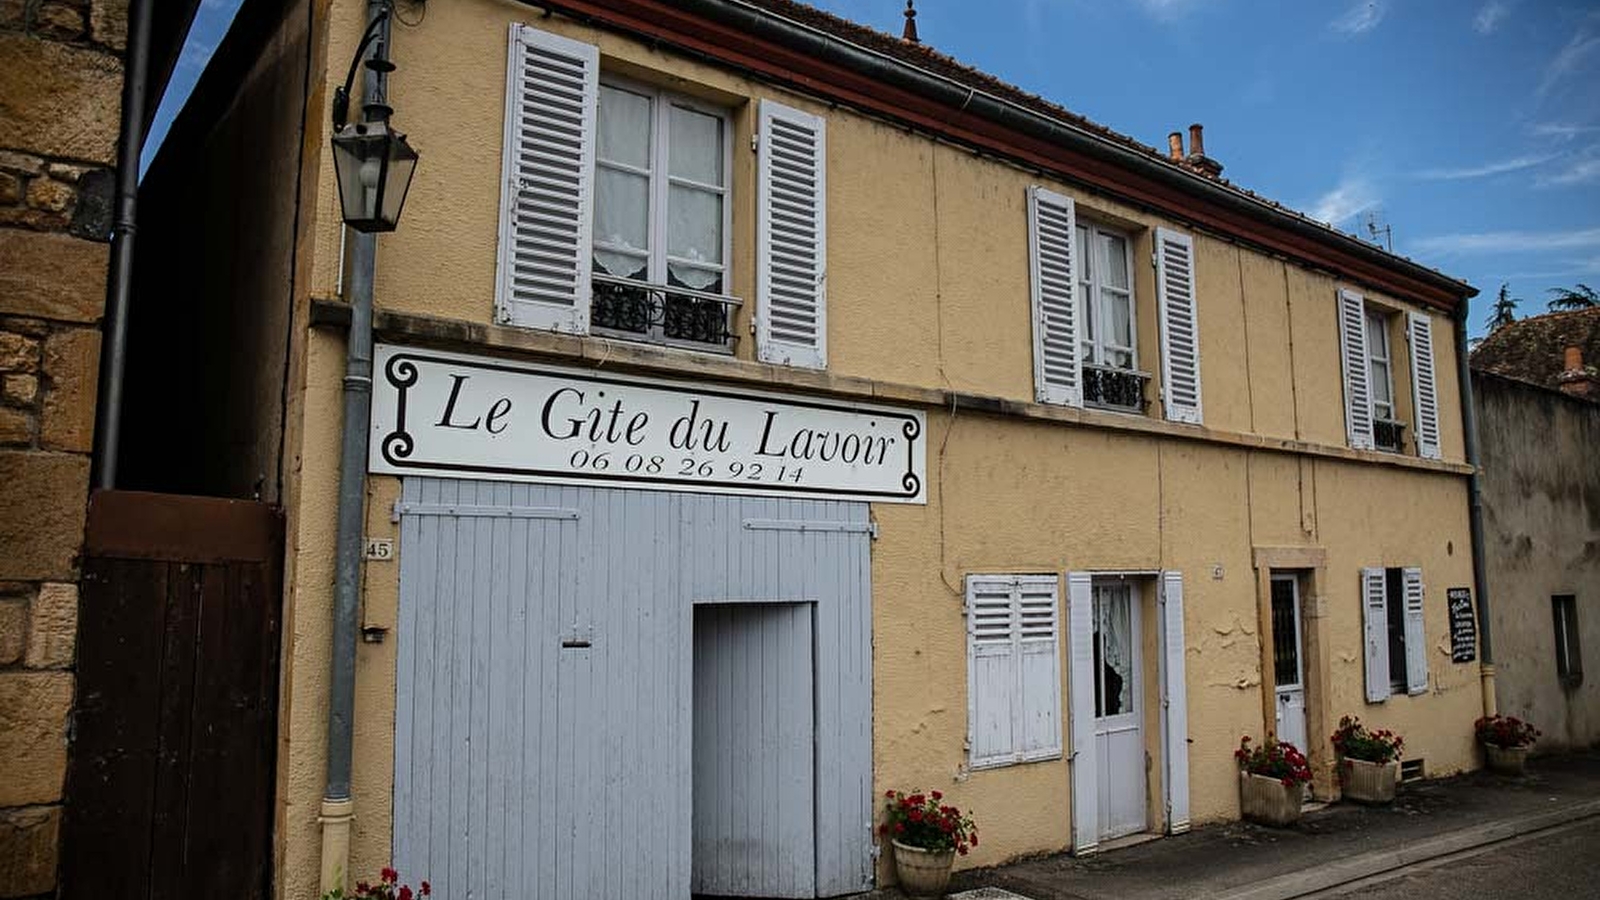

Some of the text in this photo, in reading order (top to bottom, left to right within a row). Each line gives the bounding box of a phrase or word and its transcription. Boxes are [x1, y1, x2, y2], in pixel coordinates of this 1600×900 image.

[434, 373, 896, 466] Le Gite du Lavoir
[570, 450, 804, 483] 06 08 26 92 14
[367, 543, 389, 558] 45
